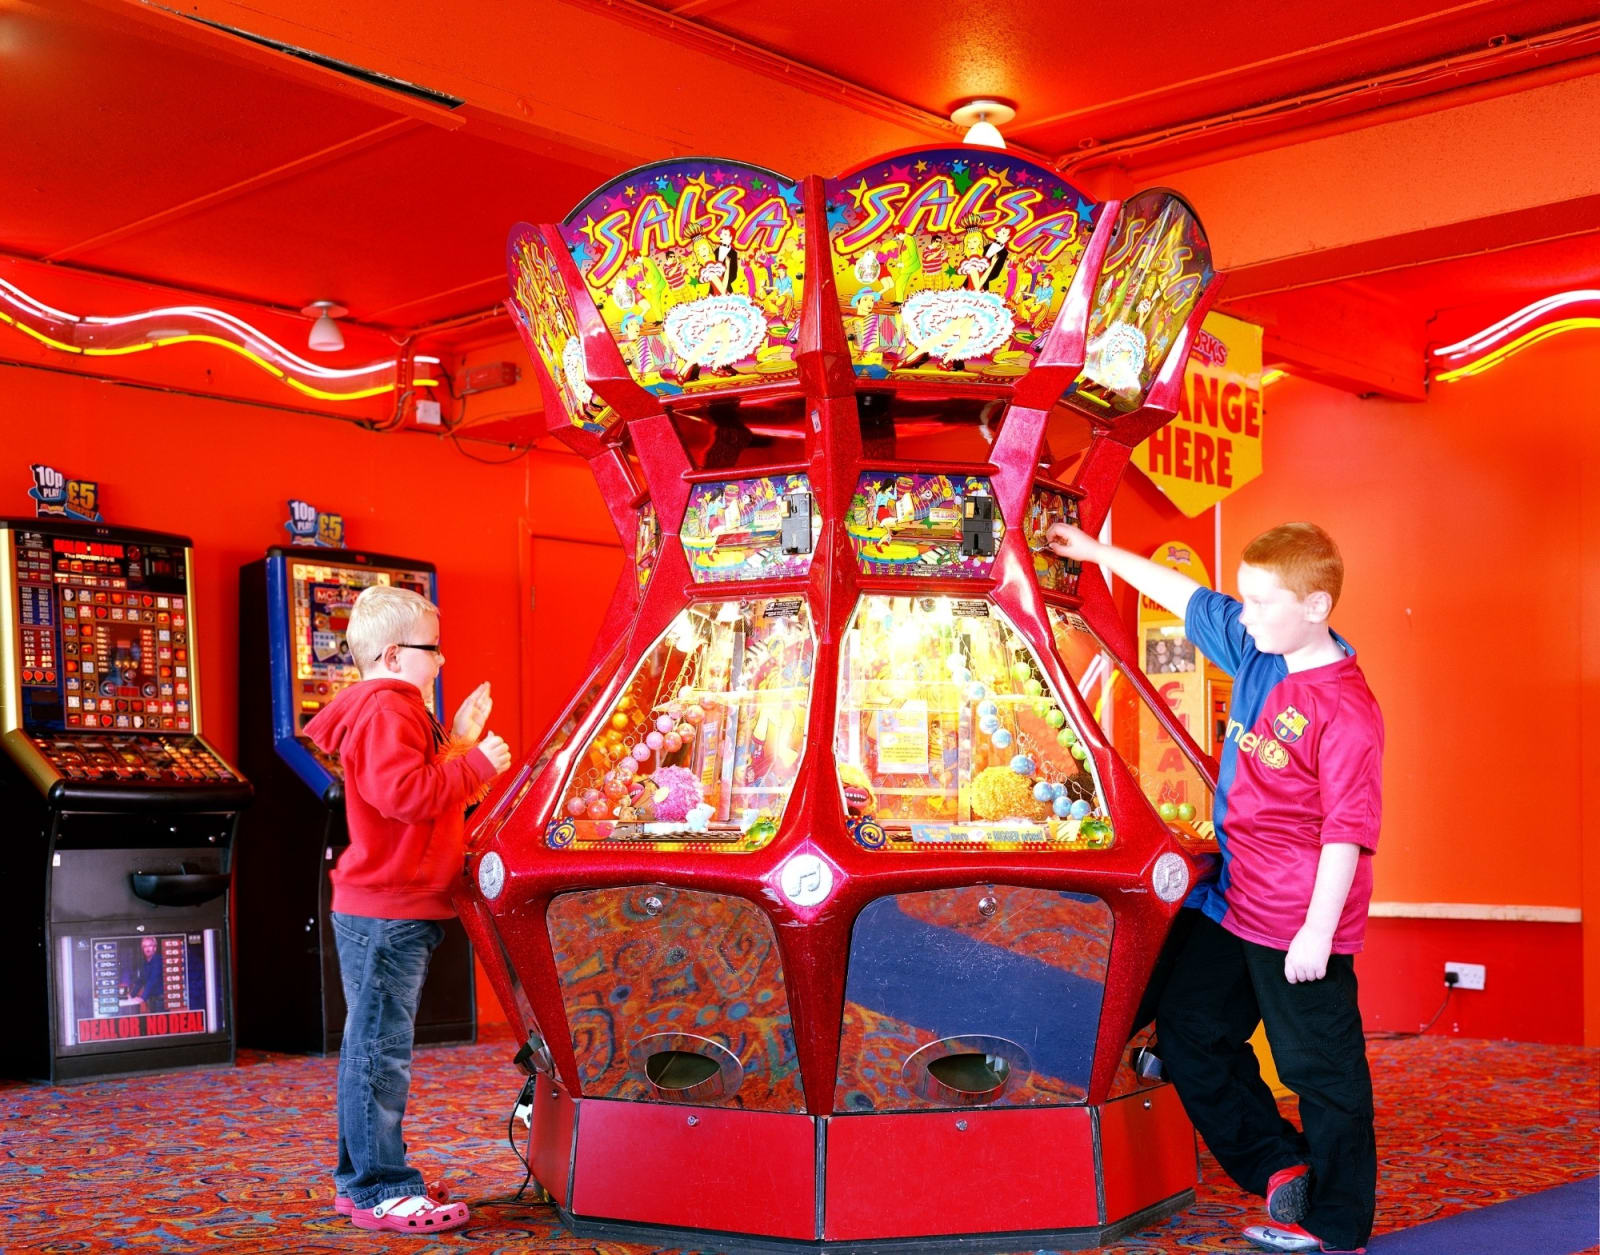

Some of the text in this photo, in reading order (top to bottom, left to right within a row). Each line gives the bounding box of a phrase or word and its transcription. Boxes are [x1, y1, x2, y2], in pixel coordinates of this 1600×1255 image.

[833, 175, 1078, 262] SALSA
[586, 184, 793, 289] SALSA
[1148, 425, 1233, 489] HERE
[36, 466, 63, 488] 10p
[68, 481, 95, 510] £5
[291, 501, 315, 521] 10p
[319, 515, 342, 540] £5
[79, 1012, 204, 1042] DEAL OR NO DEAL
